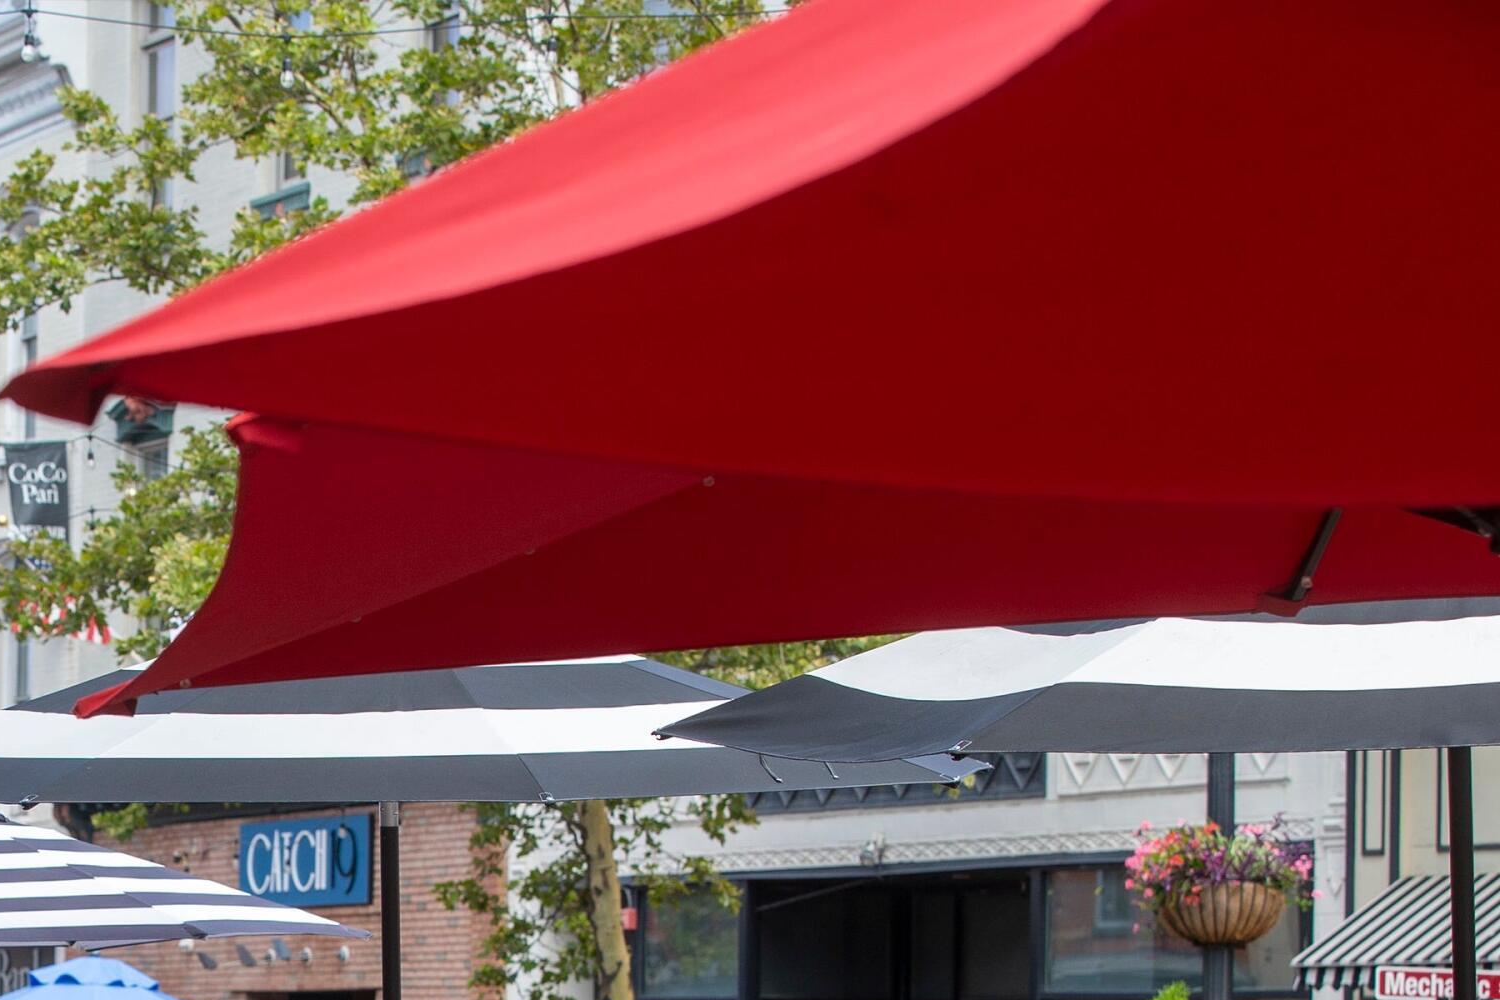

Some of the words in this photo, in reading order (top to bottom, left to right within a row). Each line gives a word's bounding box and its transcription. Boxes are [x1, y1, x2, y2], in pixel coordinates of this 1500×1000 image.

[8, 462, 67, 484] CoCo
[246, 829, 328, 895] CATCH
[1384, 971, 1490, 999] Mechac
